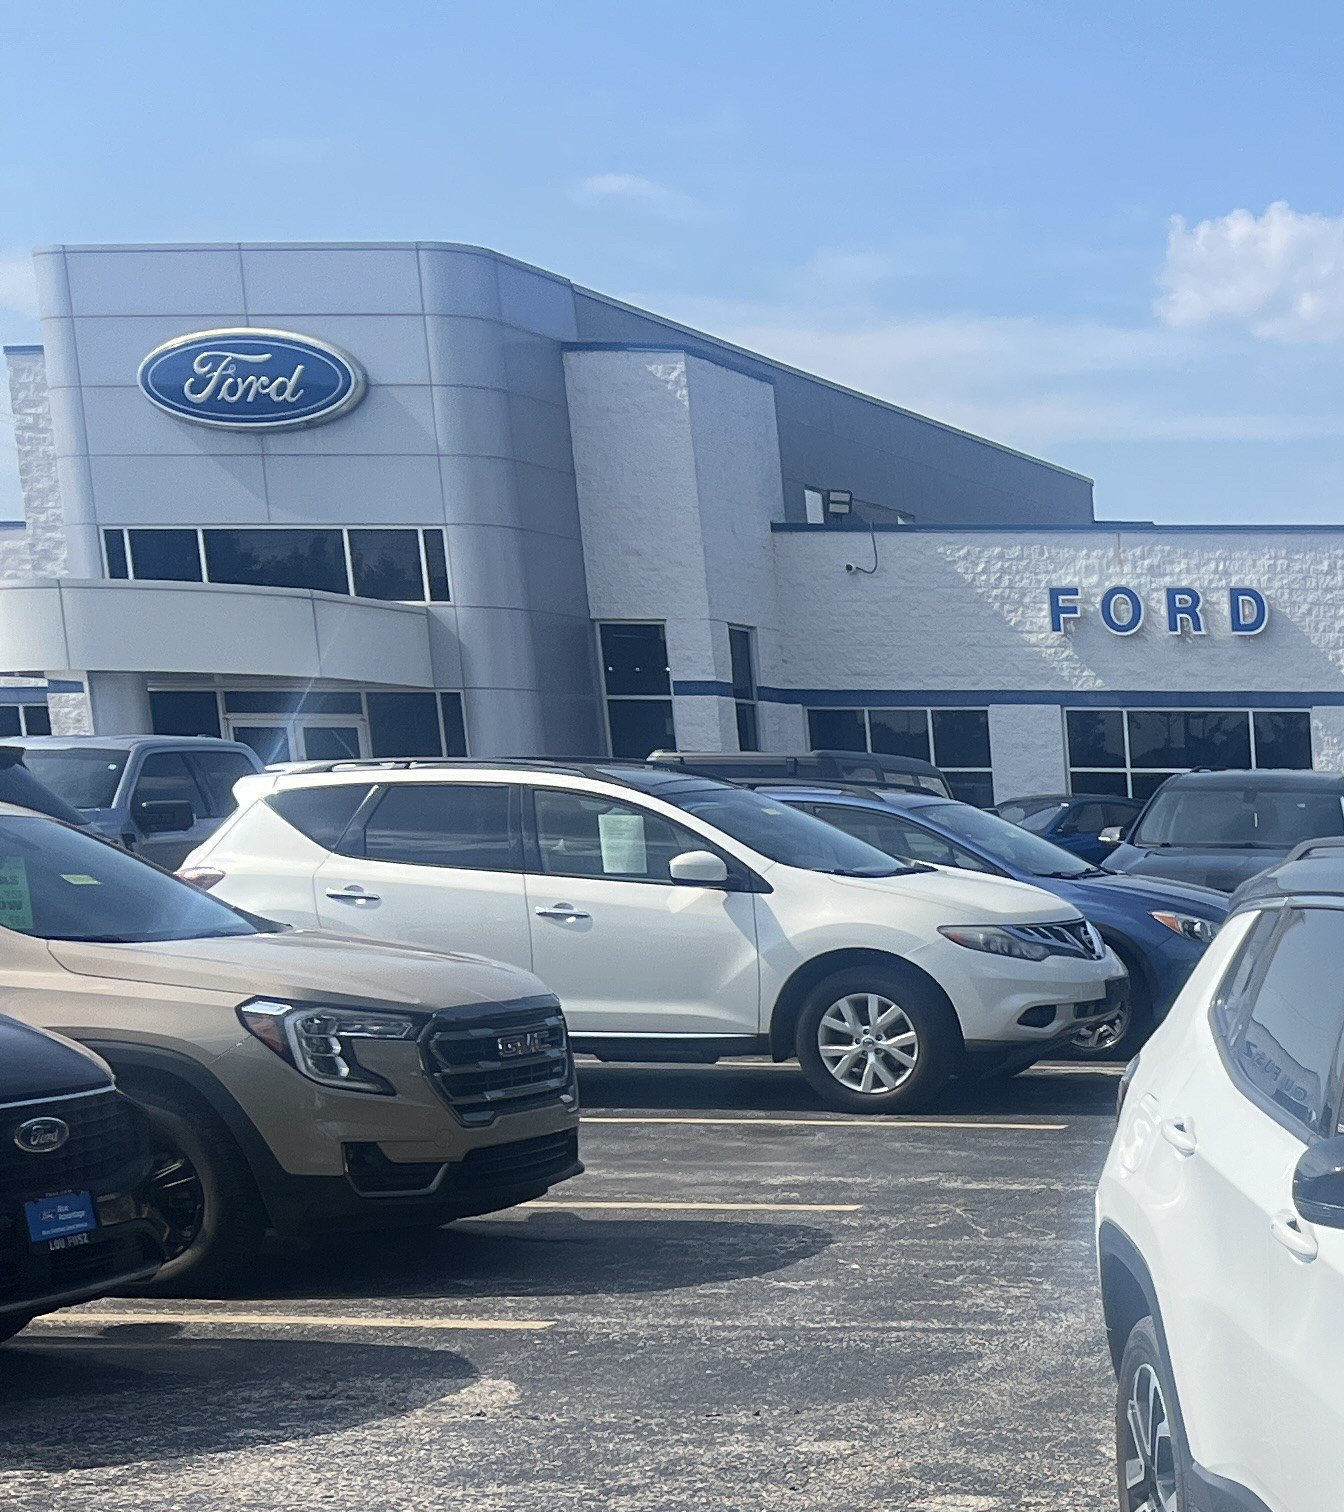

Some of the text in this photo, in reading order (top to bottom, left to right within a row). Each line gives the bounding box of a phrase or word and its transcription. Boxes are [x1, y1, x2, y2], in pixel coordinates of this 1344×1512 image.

[184, 351, 304, 404] Ford
[1049, 586, 1269, 635] FORD
[498, 1031, 551, 1057] GMC
[30, 1125, 59, 1146] Ford
